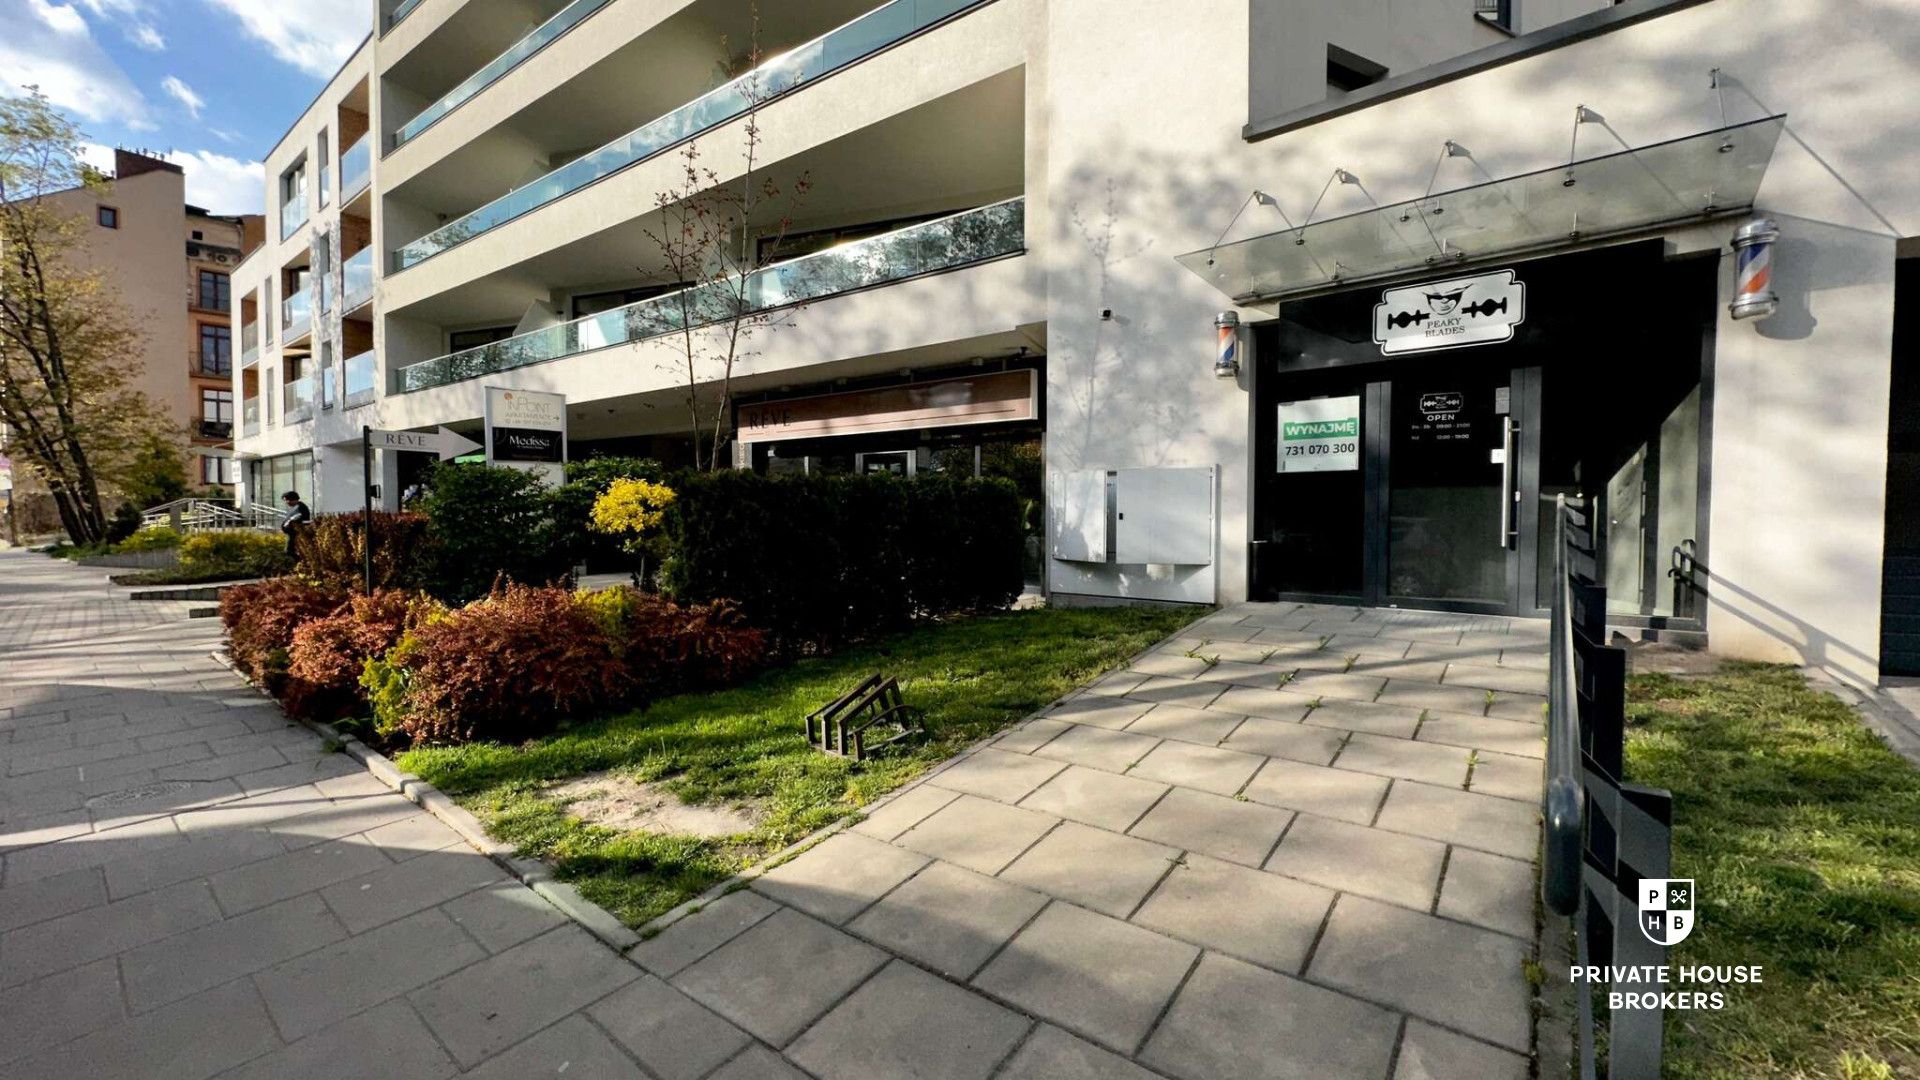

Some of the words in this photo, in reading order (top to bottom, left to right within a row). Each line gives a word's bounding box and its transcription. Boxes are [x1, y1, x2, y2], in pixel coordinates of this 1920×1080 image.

[1427, 318, 1461, 329] PEAKY
[1425, 326, 1465, 337] BLADES
[1286, 422, 1355, 435] WYNAJMĘ
[1285, 446, 1304, 455] 731
[1309, 444, 1329, 454] 070
[1333, 443, 1355, 454] 300
